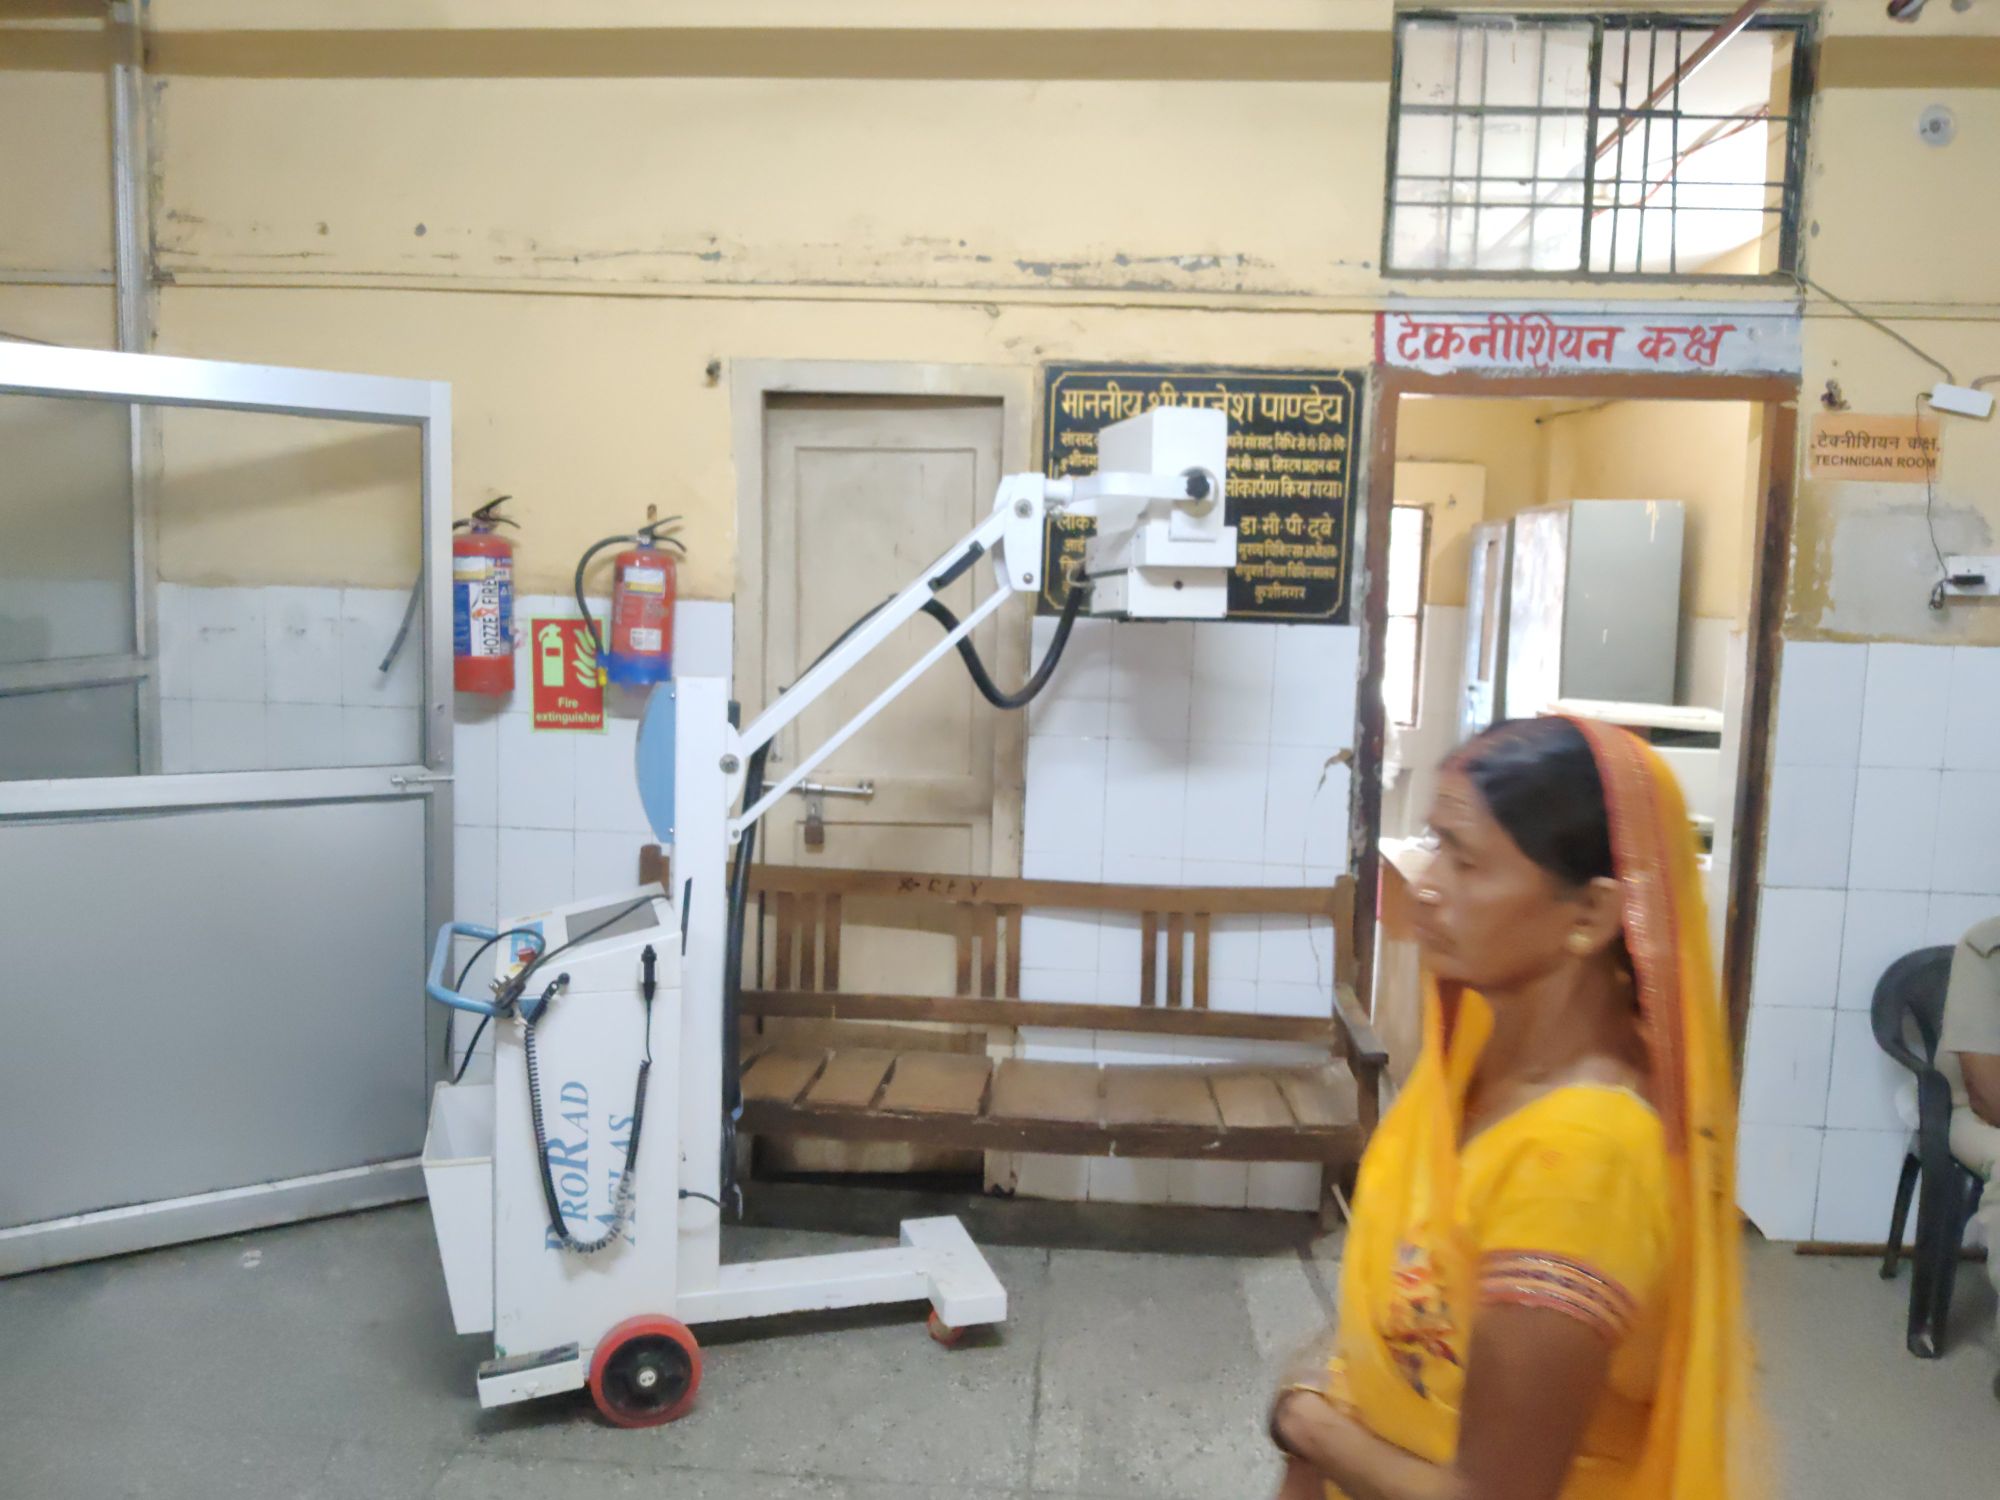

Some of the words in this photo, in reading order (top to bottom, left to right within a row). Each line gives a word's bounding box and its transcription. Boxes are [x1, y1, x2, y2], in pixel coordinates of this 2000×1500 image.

[1396, 311, 1626, 372] टेकनीशियन
[1637, 323, 1737, 367] कक्ष
[1061, 380, 1144, 419] माननीय
[1259, 385, 1343, 424] पाण्डेय
[1815, 455, 1893, 467] TECHNICIAN
[1896, 457, 1936, 468] ROOM
[557, 696, 579, 708] Fire
[536, 712, 601, 724] extinguisher
